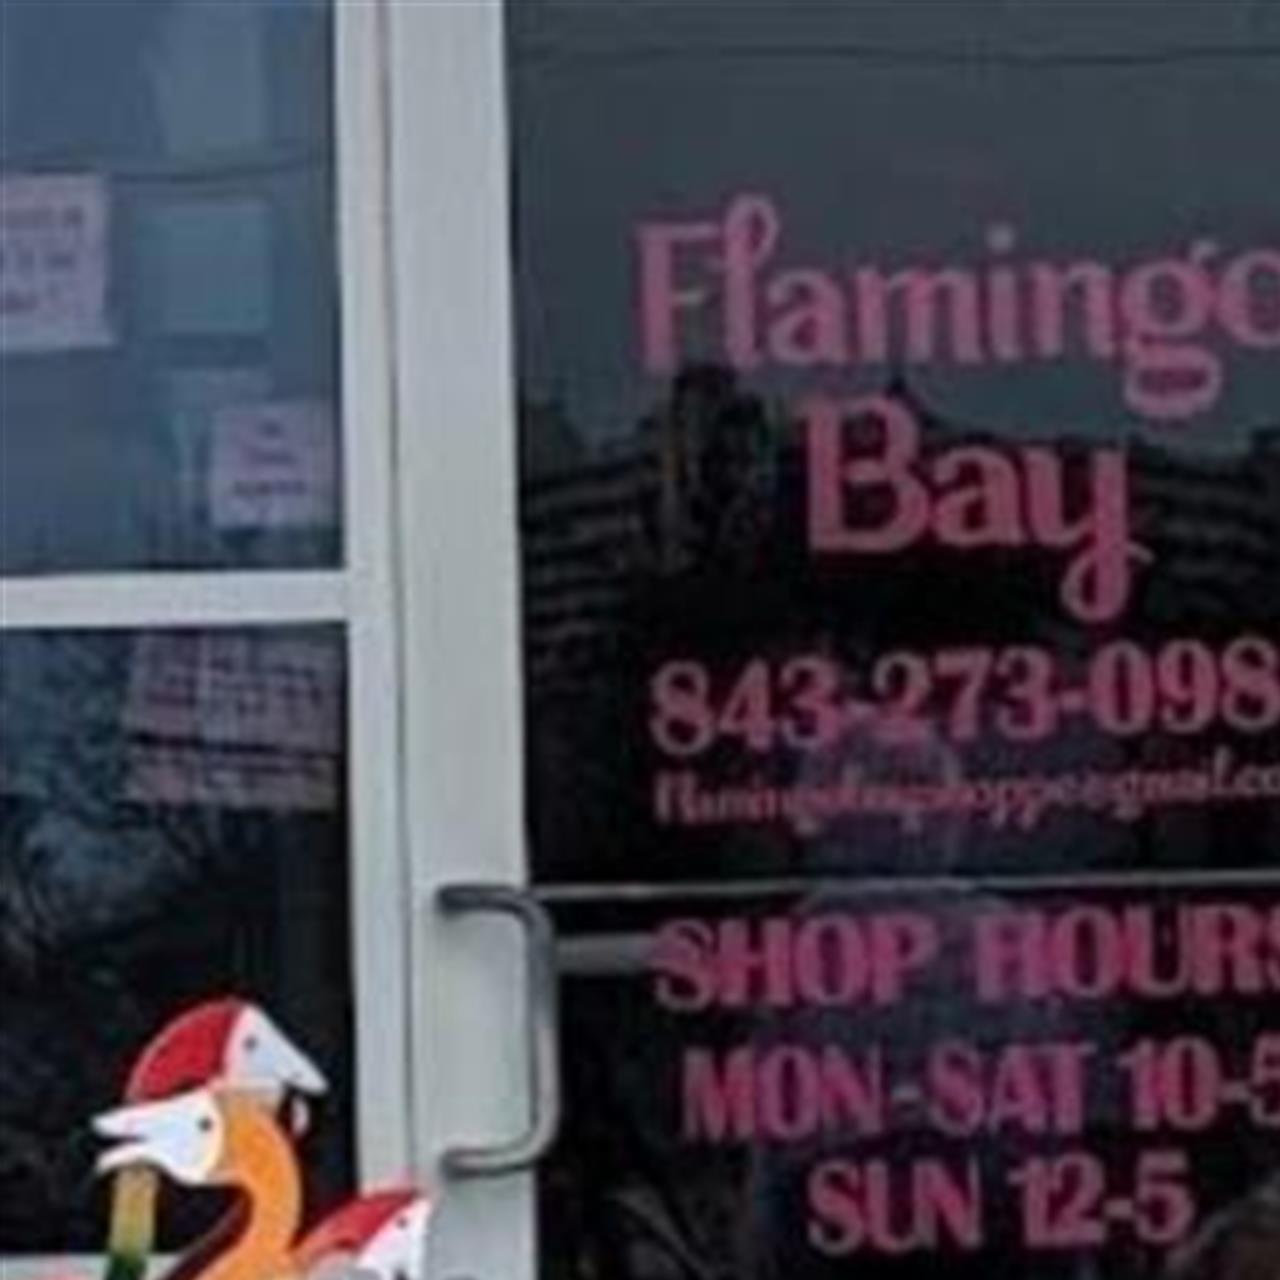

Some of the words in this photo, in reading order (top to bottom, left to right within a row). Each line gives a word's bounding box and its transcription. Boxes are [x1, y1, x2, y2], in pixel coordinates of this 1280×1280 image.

[806, 398, 1152, 622] Bay
[650, 912, 940, 1012] SHOP
[680, 1040, 1098, 1142] MON-SAT
[806, 1158, 982, 1254] SUN
[1006, 1150, 1196, 1250] 12-5
